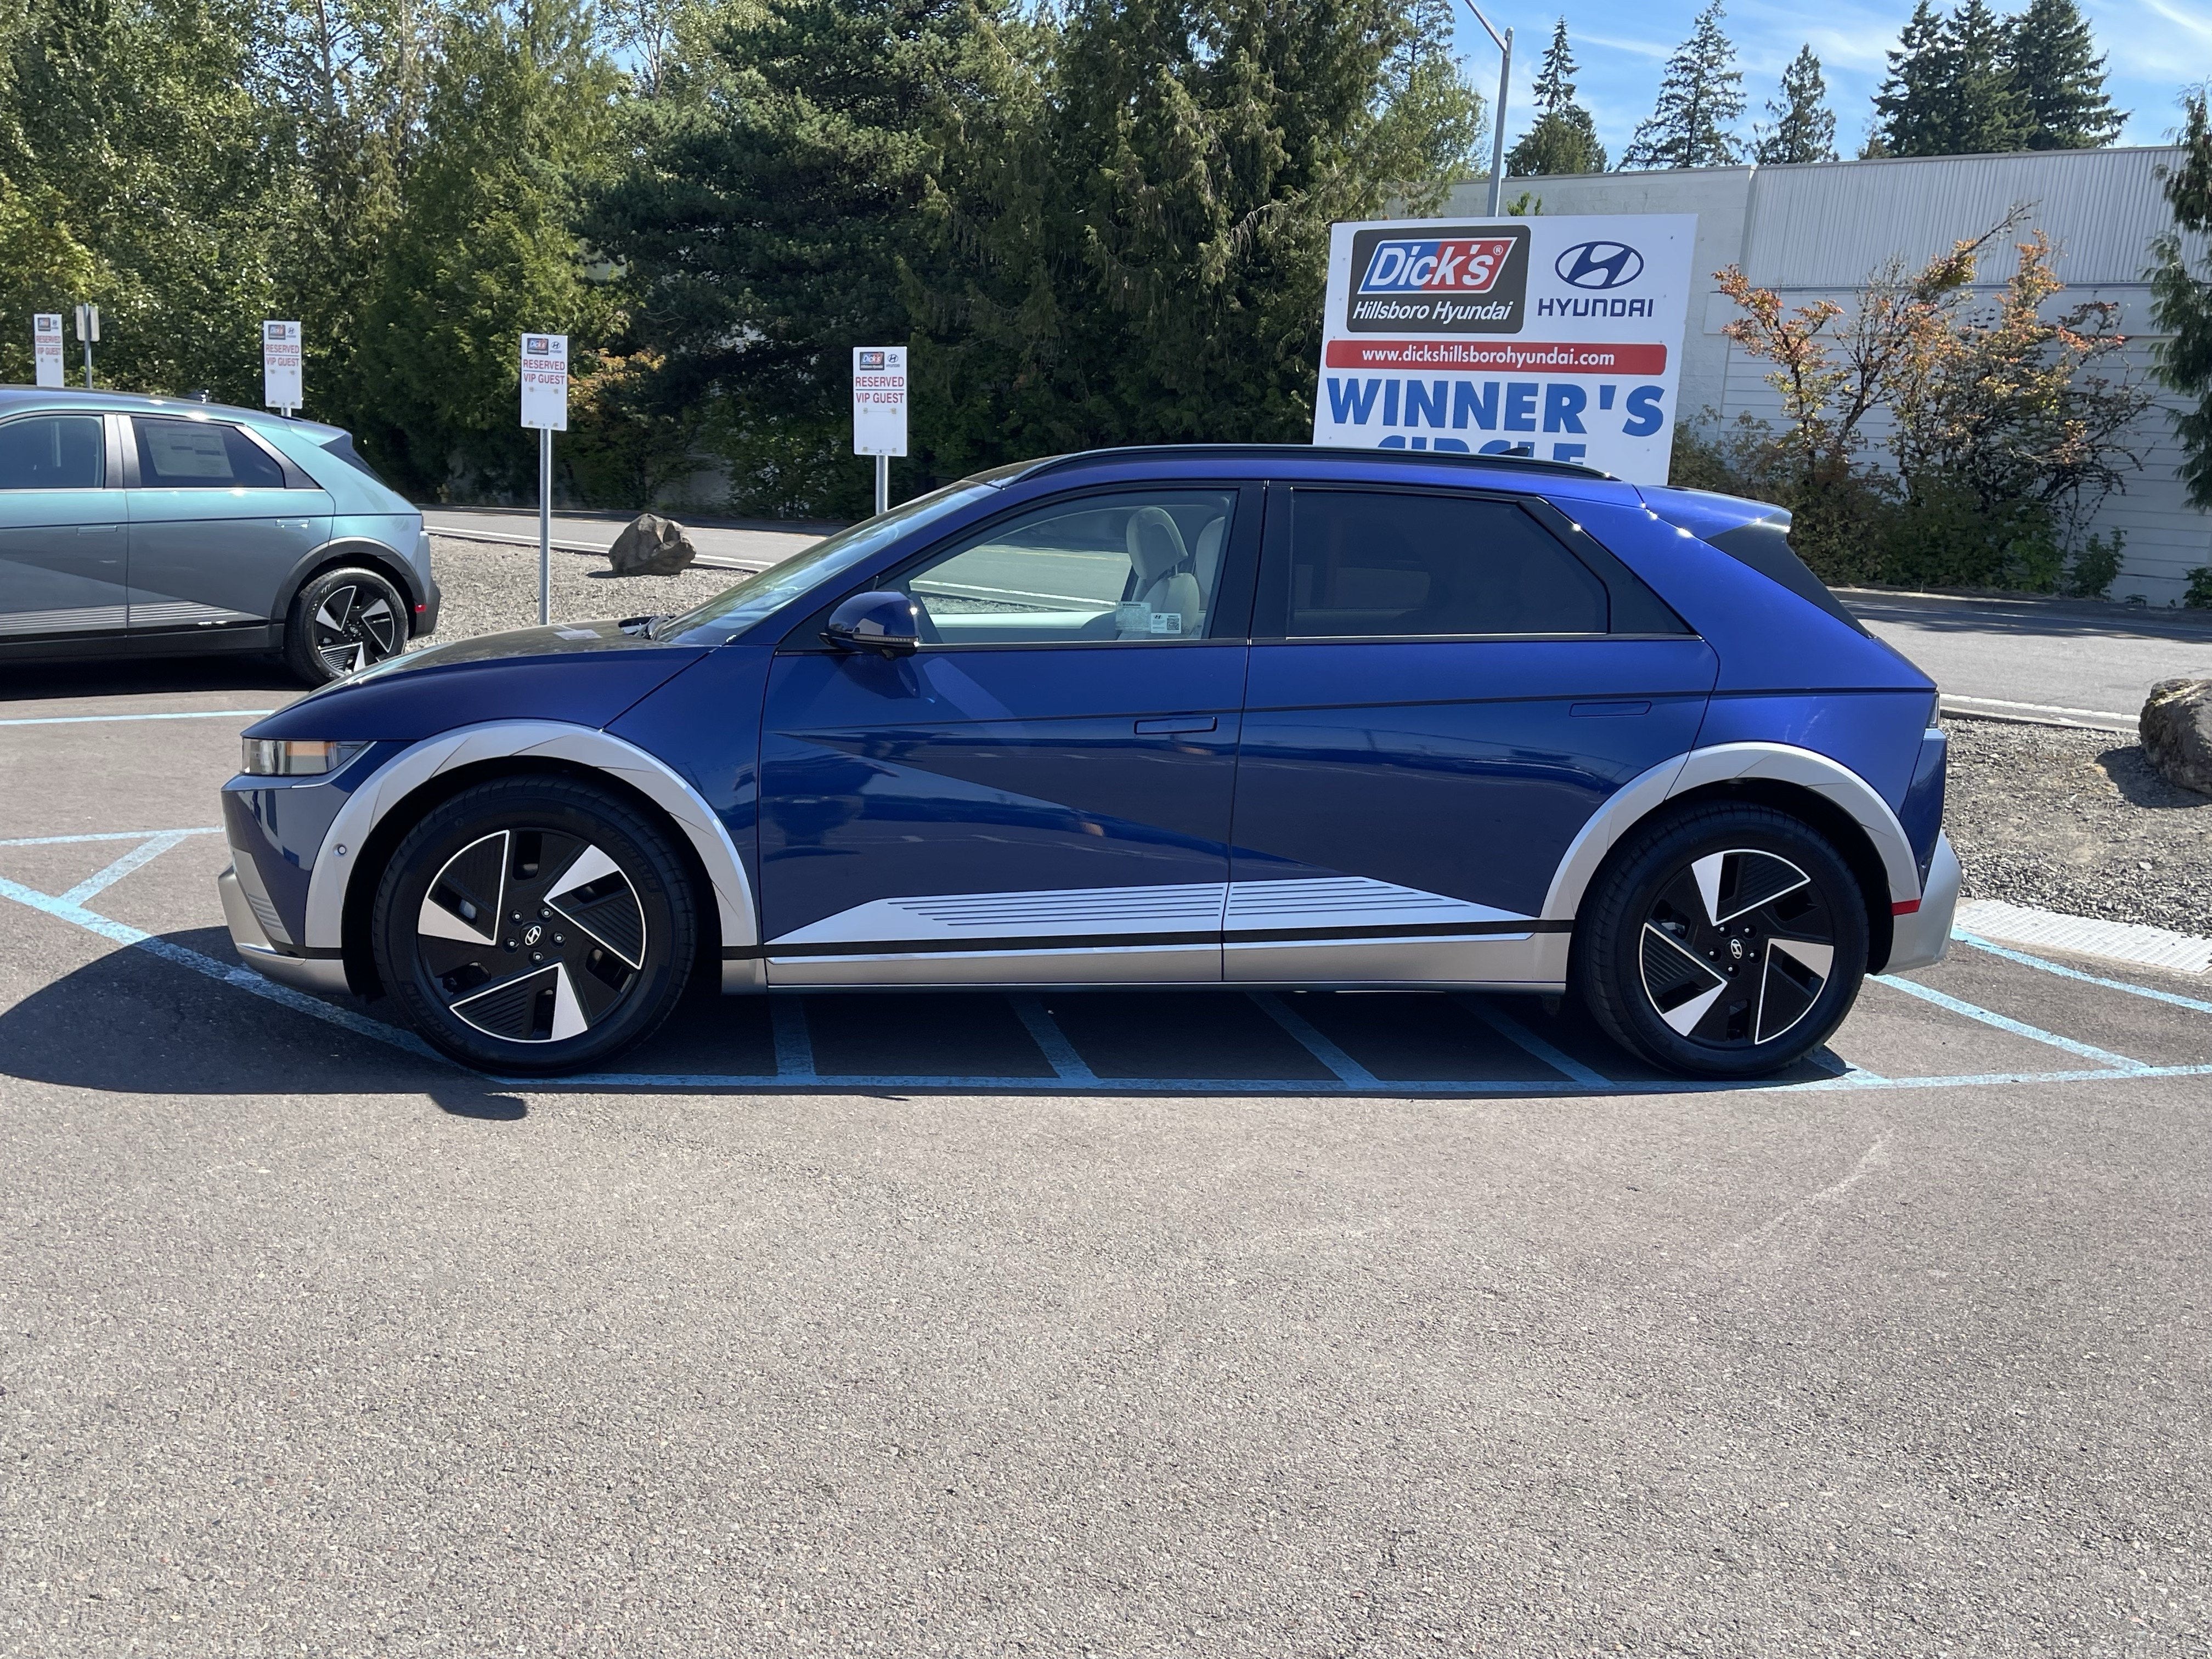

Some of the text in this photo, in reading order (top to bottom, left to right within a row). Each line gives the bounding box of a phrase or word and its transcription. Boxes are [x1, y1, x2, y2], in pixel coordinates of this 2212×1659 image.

[1369, 244, 1494, 286] Dick's
[1352, 301, 1514, 325] Hillsboro Hyundai
[1537, 298, 1654, 317] HYUNDAI
[266, 344, 300, 354] RESERVED
[266, 357, 300, 366] VIP GUEST
[1362, 344, 1615, 368] www.dickshillsborohyundai.com
[523, 359, 566, 371] RESERVED
[523, 373, 565, 385] VIP GUEST
[855, 376, 905, 387] RESERVED
[855, 392, 904, 404] VIP GUEST
[1327, 377, 1666, 437] WINNER'S
